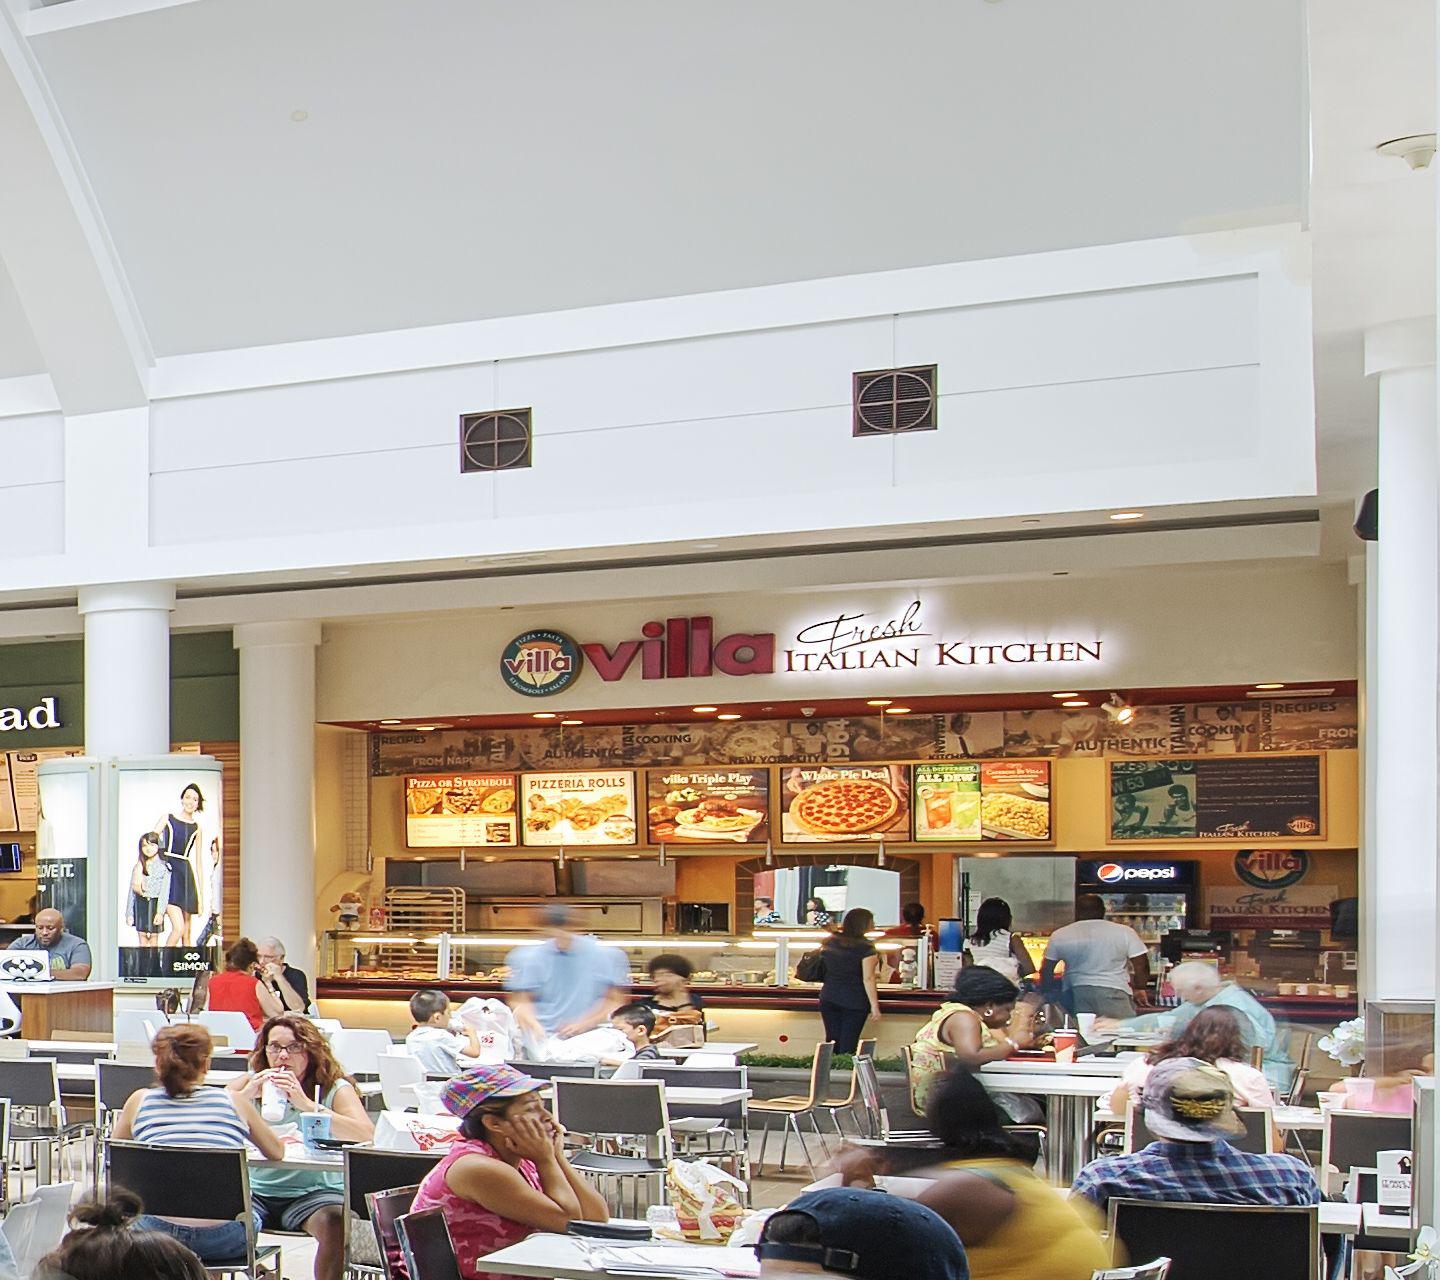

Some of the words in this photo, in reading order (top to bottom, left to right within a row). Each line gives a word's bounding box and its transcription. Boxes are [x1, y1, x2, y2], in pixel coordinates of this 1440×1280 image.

[796, 600, 932, 657] Fresh
[581, 616, 775, 682] villa
[504, 649, 572, 675] villa
[784, 648, 921, 672] ITALIAN
[935, 640, 1104, 666] KITCHEN
[1274, 702, 1338, 714] RECIPES
[1170, 705, 1186, 754] ITALIAN
[1188, 723, 1259, 737] COOKING
[381, 734, 427, 746] RECIPES
[635, 734, 692, 745] COOKING
[1074, 737, 1167, 752] AUTHENTIC
[544, 747, 620, 759] AUTHENTIC
[412, 756, 444, 766] FROM
[662, 775, 688, 785] villa
[691, 773, 726, 785] Triple
[727, 773, 753, 785] Play
[801, 770, 837, 781] Whole
[840, 770, 859, 780] Pie
[861, 769, 889, 780] Deal
[917, 773, 944, 783] ALL
[945, 773, 977, 783] DEW
[409, 777, 437, 788] PIZZA
[438, 779, 452, 788] OR
[453, 776, 513, 788] STROMBOLI
[530, 778, 584, 790] PIZZERIA
[588, 776, 626, 788] ROLLS
[1236, 829, 1280, 838] KITCHEN
[1239, 851, 1302, 871] villa
[1124, 866, 1176, 881] pepsi
[1236, 888, 1289, 905] Fresh
[1210, 904, 1265, 915] ITALIAN
[1268, 903, 1331, 915] KITCHEN
[173, 961, 210, 971] SIMON
